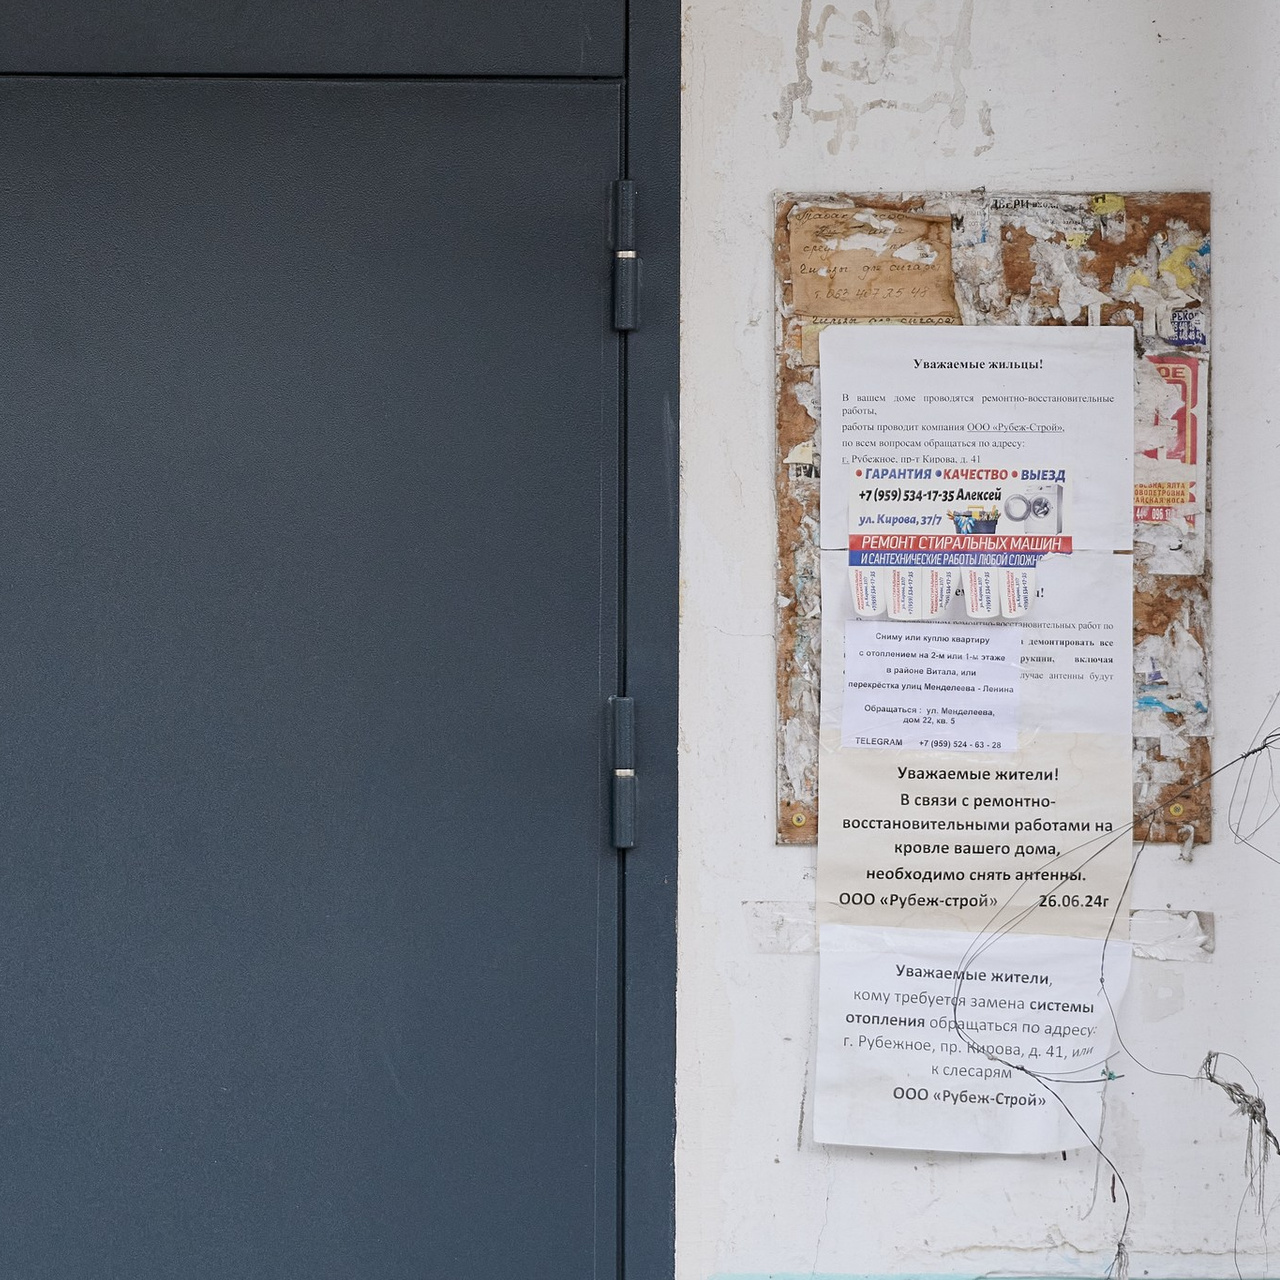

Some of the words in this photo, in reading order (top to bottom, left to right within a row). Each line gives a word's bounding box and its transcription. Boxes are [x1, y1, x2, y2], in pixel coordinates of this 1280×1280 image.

[913, 359, 986, 370] Уважаемые
[989, 359, 1043, 370] жильцы!
[842, 393, 849, 402] В
[924, 395, 974, 404] проводятся
[982, 395, 1115, 404] ремонтно-восстановительные
[842, 406, 877, 417] работы,
[842, 423, 875, 433] работы
[877, 424, 919, 433] проводит
[922, 424, 965, 432] компания
[967, 423, 991, 432] ООО
[993, 422, 1065, 433] «Рубеж-Строй»,
[879, 441, 921, 449] вопросам
[924, 439, 976, 449] обращаться
[992, 440, 1025, 449] адресу:
[971, 455, 980, 463] 41
[865, 468, 932, 479] ГАРАНТИЯ
[943, 469, 1009, 480] КАЧЕСТВО
[1021, 469, 1066, 483] ВЫЕЗД
[859, 490, 872, 501] +7
[874, 487, 901, 502] (959)
[903, 490, 955, 502] 534-17-35
[956, 487, 1002, 501] Алексей
[858, 516, 874, 526] ул.
[877, 514, 919, 526] Кирова,
[920, 514, 942, 526] 37/7
[862, 536, 917, 549] РЕМОНТ
[919, 536, 1007, 550] СТИРАЛЬНЫХ
[1010, 537, 1062, 550] МАШИН
[861, 552, 869, 564] И
[869, 552, 942, 565] САНТЕХНИЧЕСКИЕ
[943, 553, 977, 565] РАБОТЫ
[978, 552, 1008, 565] ЛЮБОЙ
[1078, 621, 1100, 631] работ
[876, 632, 903, 641] Сниму
[923, 635, 949, 643] куплю
[952, 637, 990, 645] квартиру
[1028, 639, 1094, 648] демонтировать
[894, 667, 924, 675] районе
[926, 668, 959, 676] Витала,
[1089, 671, 1113, 682] будут
[924, 683, 975, 692] Менделеева
[983, 685, 1014, 693] Ленина
[864, 704, 917, 714] Обращаться
[941, 707, 995, 717] Менделеева,
[922, 717, 934, 725] 22,
[855, 737, 903, 746] TELEGRAM
[930, 740, 951, 749] (959)
[953, 740, 967, 748] 524
[897, 766, 990, 780] Уважаемые
[995, 767, 1059, 781] жители!
[900, 793, 910, 806] В
[914, 796, 957, 806] связи
[961, 797, 969, 807] с
[973, 797, 1056, 810] ремонтно-
[842, 819, 1010, 831] восстановительными
[1014, 818, 1090, 834] работами
[1095, 821, 1113, 832] на
[894, 843, 949, 856] кровле
[954, 844, 1010, 855] вашего
[1014, 845, 1061, 857] дома,
[866, 867, 965, 883] необходимо
[969, 871, 1011, 881] снять
[1015, 871, 1086, 881] антенны.
[839, 892, 875, 906] ООО
[880, 893, 998, 909] «Рубеж-строй»
[1038, 894, 1109, 908] 26.06.24г
[896, 964, 986, 981] Уважаемые
[991, 973, 1053, 987] жители,
[853, 990, 890, 1004] кому
[894, 991, 966, 1008] требуется
[970, 997, 1025, 1010] замена
[1029, 1000, 1094, 1013] системы
[845, 1013, 925, 1028] отопления
[929, 1015, 1018, 1033] обращаться
[1022, 1024, 1040, 1034] по
[1044, 1025, 1098, 1038] адресу:
[843, 1036, 853, 1046] г.
[858, 1035, 936, 1053] Рубежное,
[940, 1042, 962, 1055] пр.
[967, 1041, 1025, 1058] Кирова,
[1028, 1047, 1041, 1059] д.
[1045, 1045, 1068, 1060] 41,
[1072, 1046, 1094, 1058] или
[931, 1065, 939, 1075] к
[942, 1066, 1012, 1080] слесарям
[893, 1086, 929, 1101] ООО
[933, 1089, 1046, 1108] «Рубеж-Строй»
